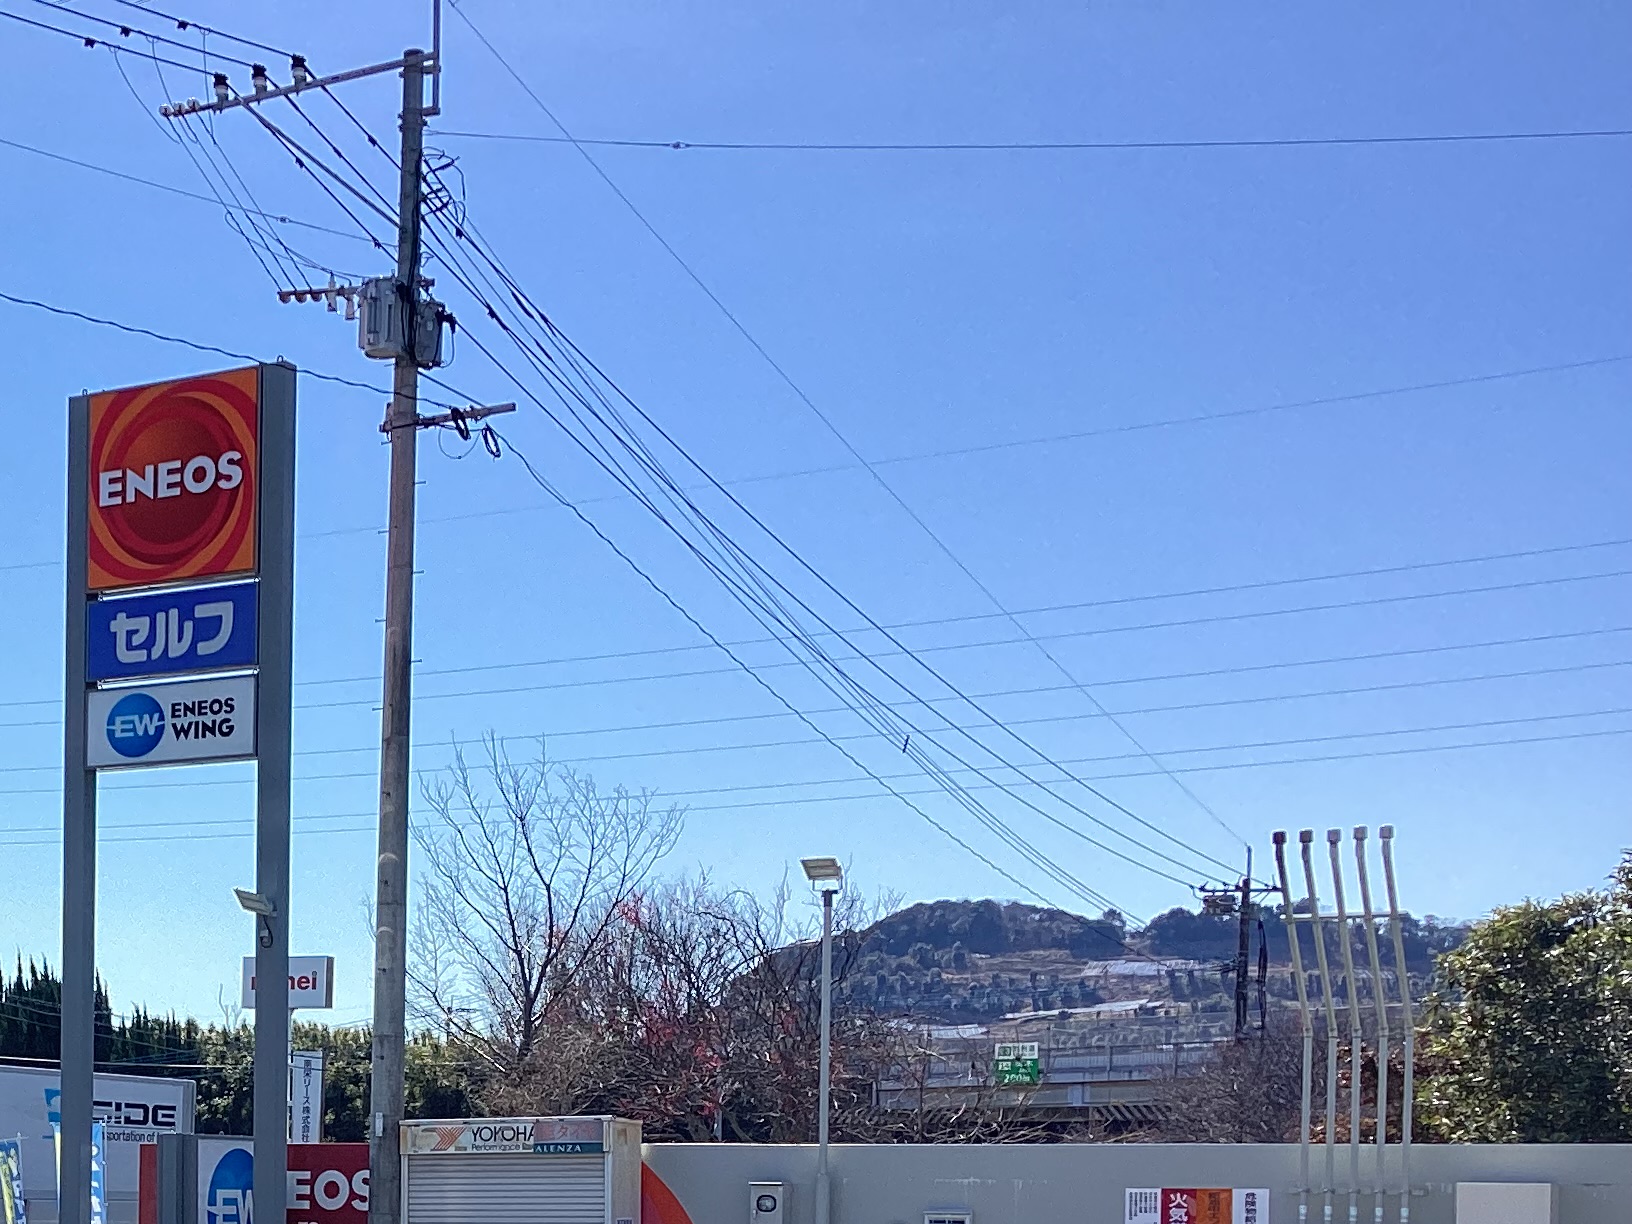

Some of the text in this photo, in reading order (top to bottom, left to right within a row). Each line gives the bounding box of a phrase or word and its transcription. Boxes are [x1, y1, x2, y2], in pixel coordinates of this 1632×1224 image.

[99, 450, 243, 508] ENEOS
[109, 600, 234, 664] セルフ
[171, 696, 235, 718] ENEOS
[113, 712, 160, 738] EW
[172, 717, 235, 741] WING
[535, 1144, 582, 1153] ALENZA
